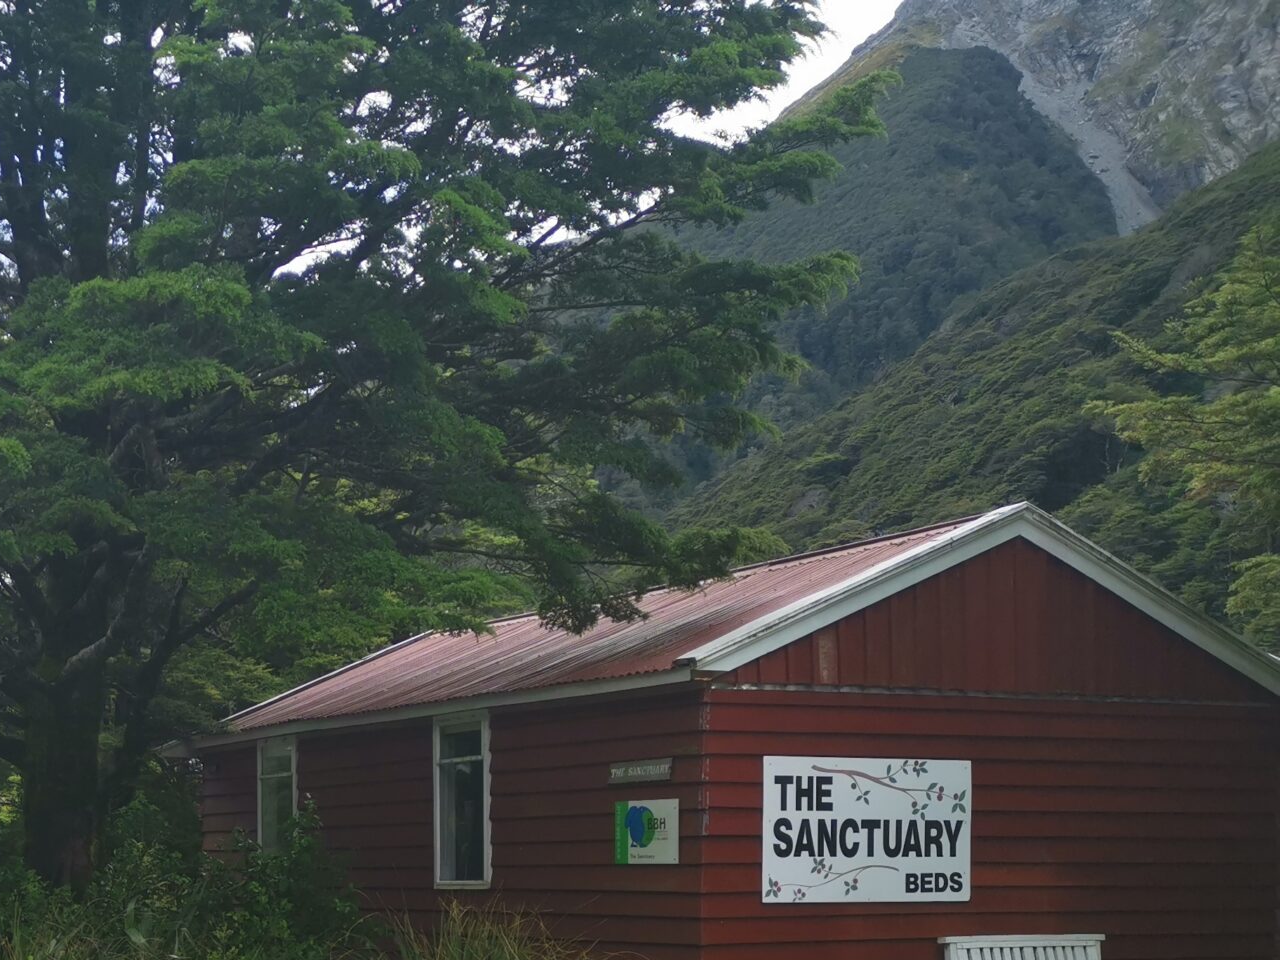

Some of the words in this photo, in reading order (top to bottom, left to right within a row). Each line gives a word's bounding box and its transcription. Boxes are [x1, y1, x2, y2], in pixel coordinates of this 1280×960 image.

[611, 768, 625, 778] THE
[628, 764, 670, 776] SANCTUARY
[774, 775, 833, 811] THE
[648, 818, 666, 830] BBH
[772, 817, 964, 858] SANCTUARY
[905, 872, 963, 893] BEDS
